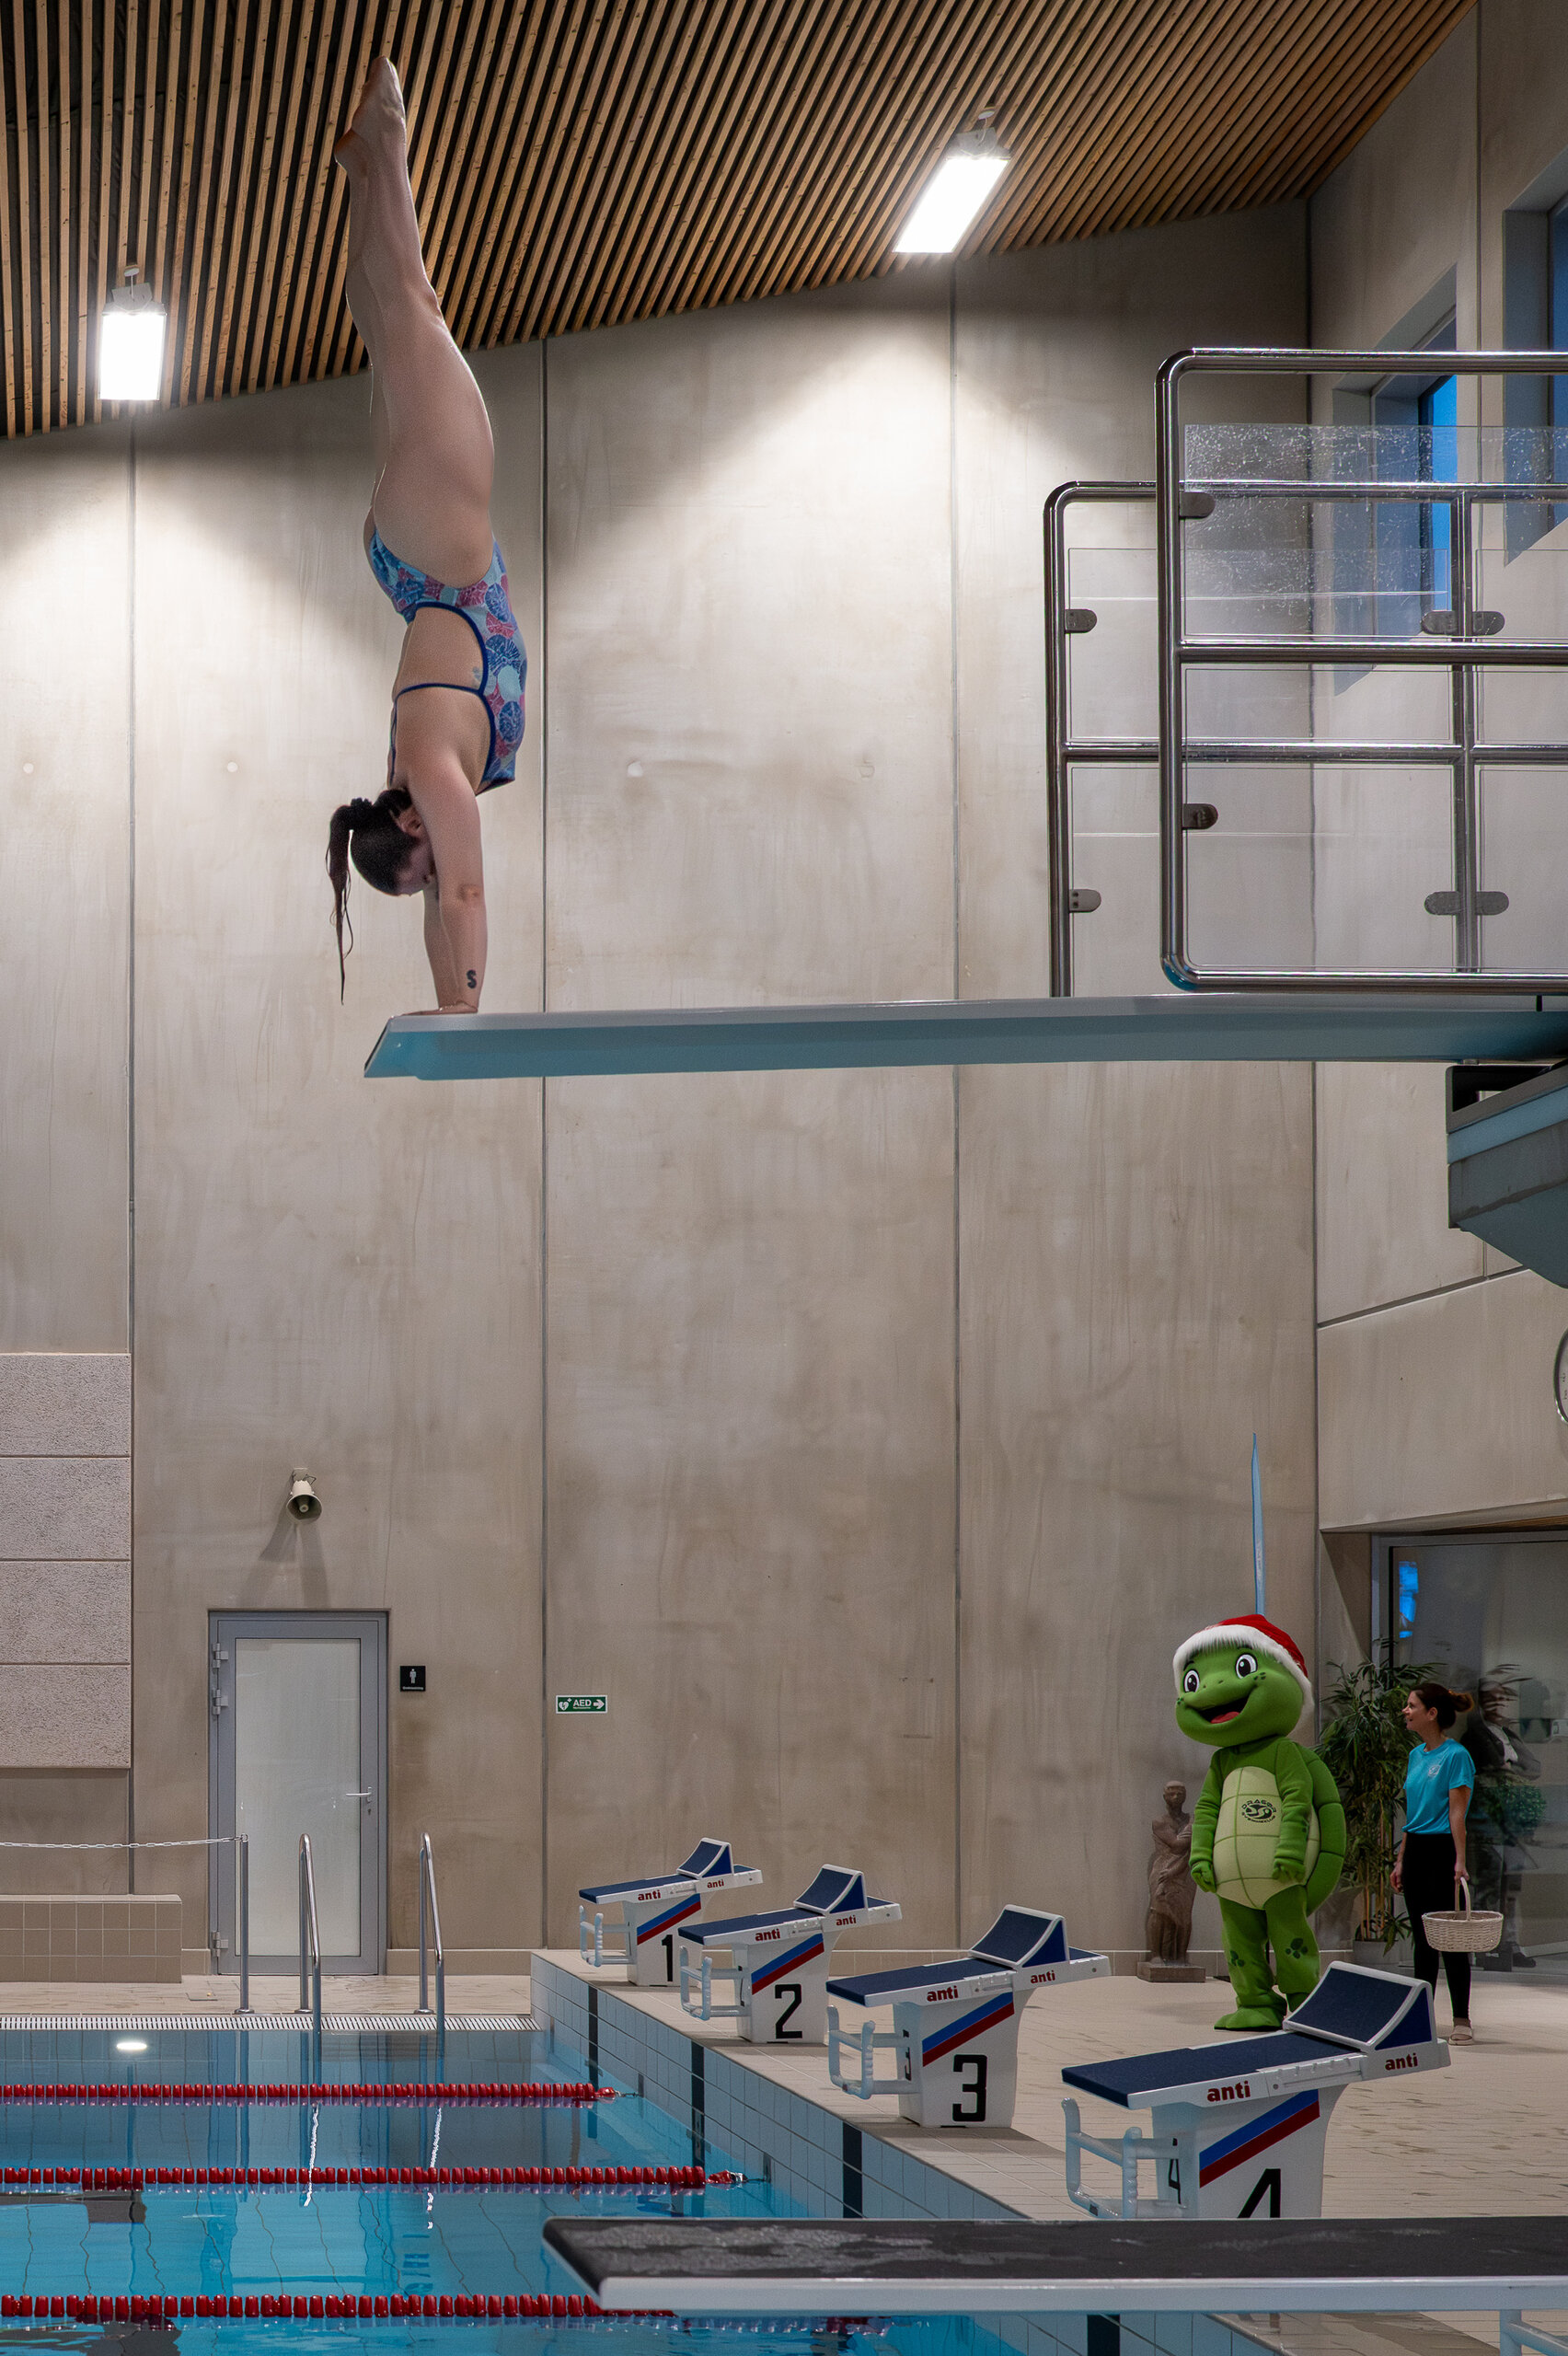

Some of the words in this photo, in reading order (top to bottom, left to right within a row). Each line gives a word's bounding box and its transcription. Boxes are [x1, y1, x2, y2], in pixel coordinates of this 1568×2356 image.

[572, 1699, 592, 1707] AED
[638, 1889, 662, 1901] anti
[707, 1879, 725, 1889] anti
[755, 1928, 781, 1942] anti
[836, 1914, 857, 1926] anti
[661, 1934, 674, 1982] 1
[927, 1985, 959, 2003] anti
[1030, 1969, 1056, 1985] anti
[775, 1983, 803, 2039] 2
[951, 2054, 988, 2122] 3
[1206, 2080, 1251, 2103] anti
[1384, 2052, 1419, 2072] anti
